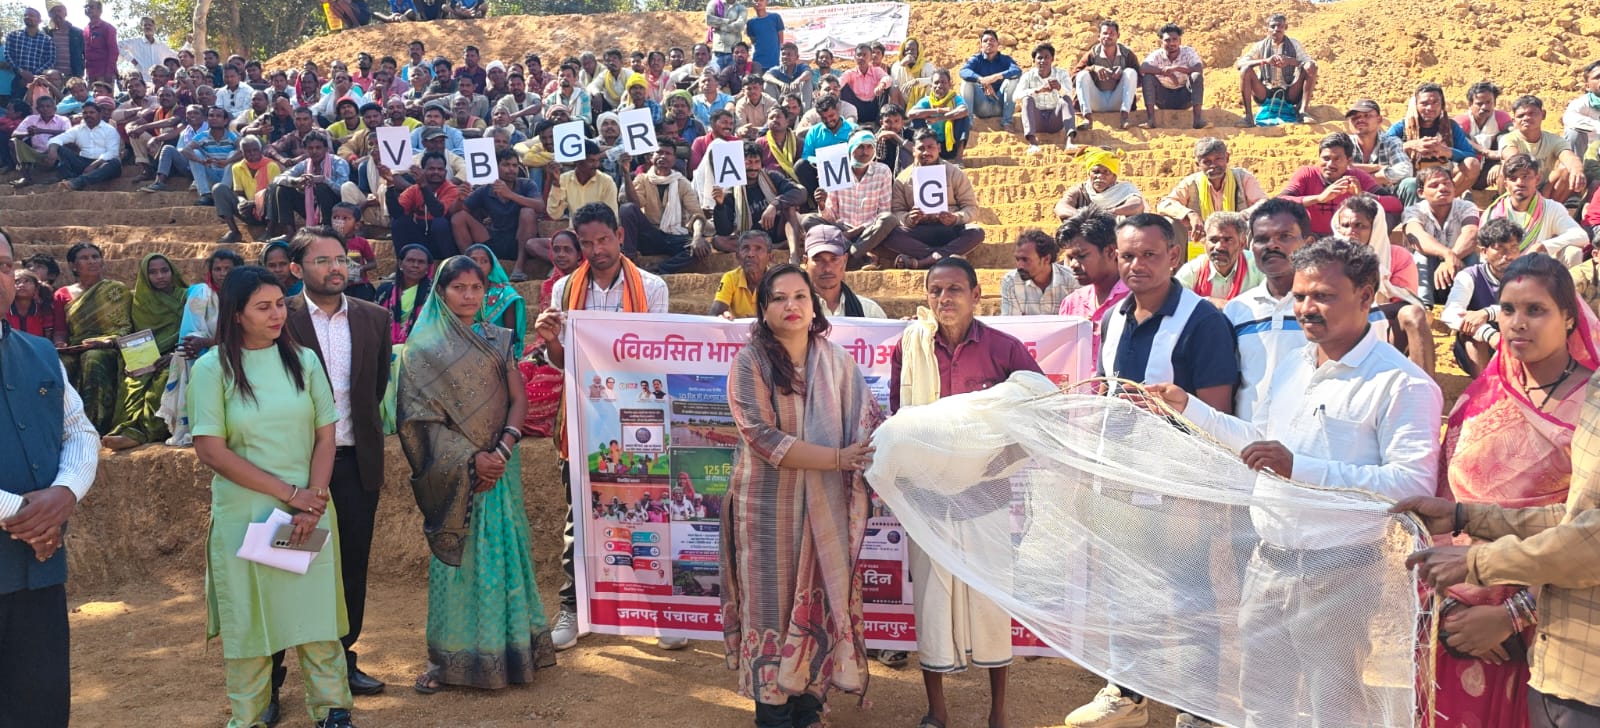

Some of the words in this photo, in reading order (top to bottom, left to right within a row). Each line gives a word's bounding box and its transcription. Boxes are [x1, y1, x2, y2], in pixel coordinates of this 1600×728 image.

[560, 133, 583, 157] G
[627, 123, 653, 150] R
[383, 139, 408, 165] V
[471, 151, 492, 178] B
[718, 156, 743, 184] A
[823, 156, 852, 187] M
[919, 180, 944, 208] G
[613, 333, 703, 362] (विकसित
[708, 342, 747, 362] भार
[704, 465, 720, 475] 125
[863, 569, 893, 585] दिन
[617, 608, 658, 622] जनपद
[663, 606, 710, 624] पंचायत
